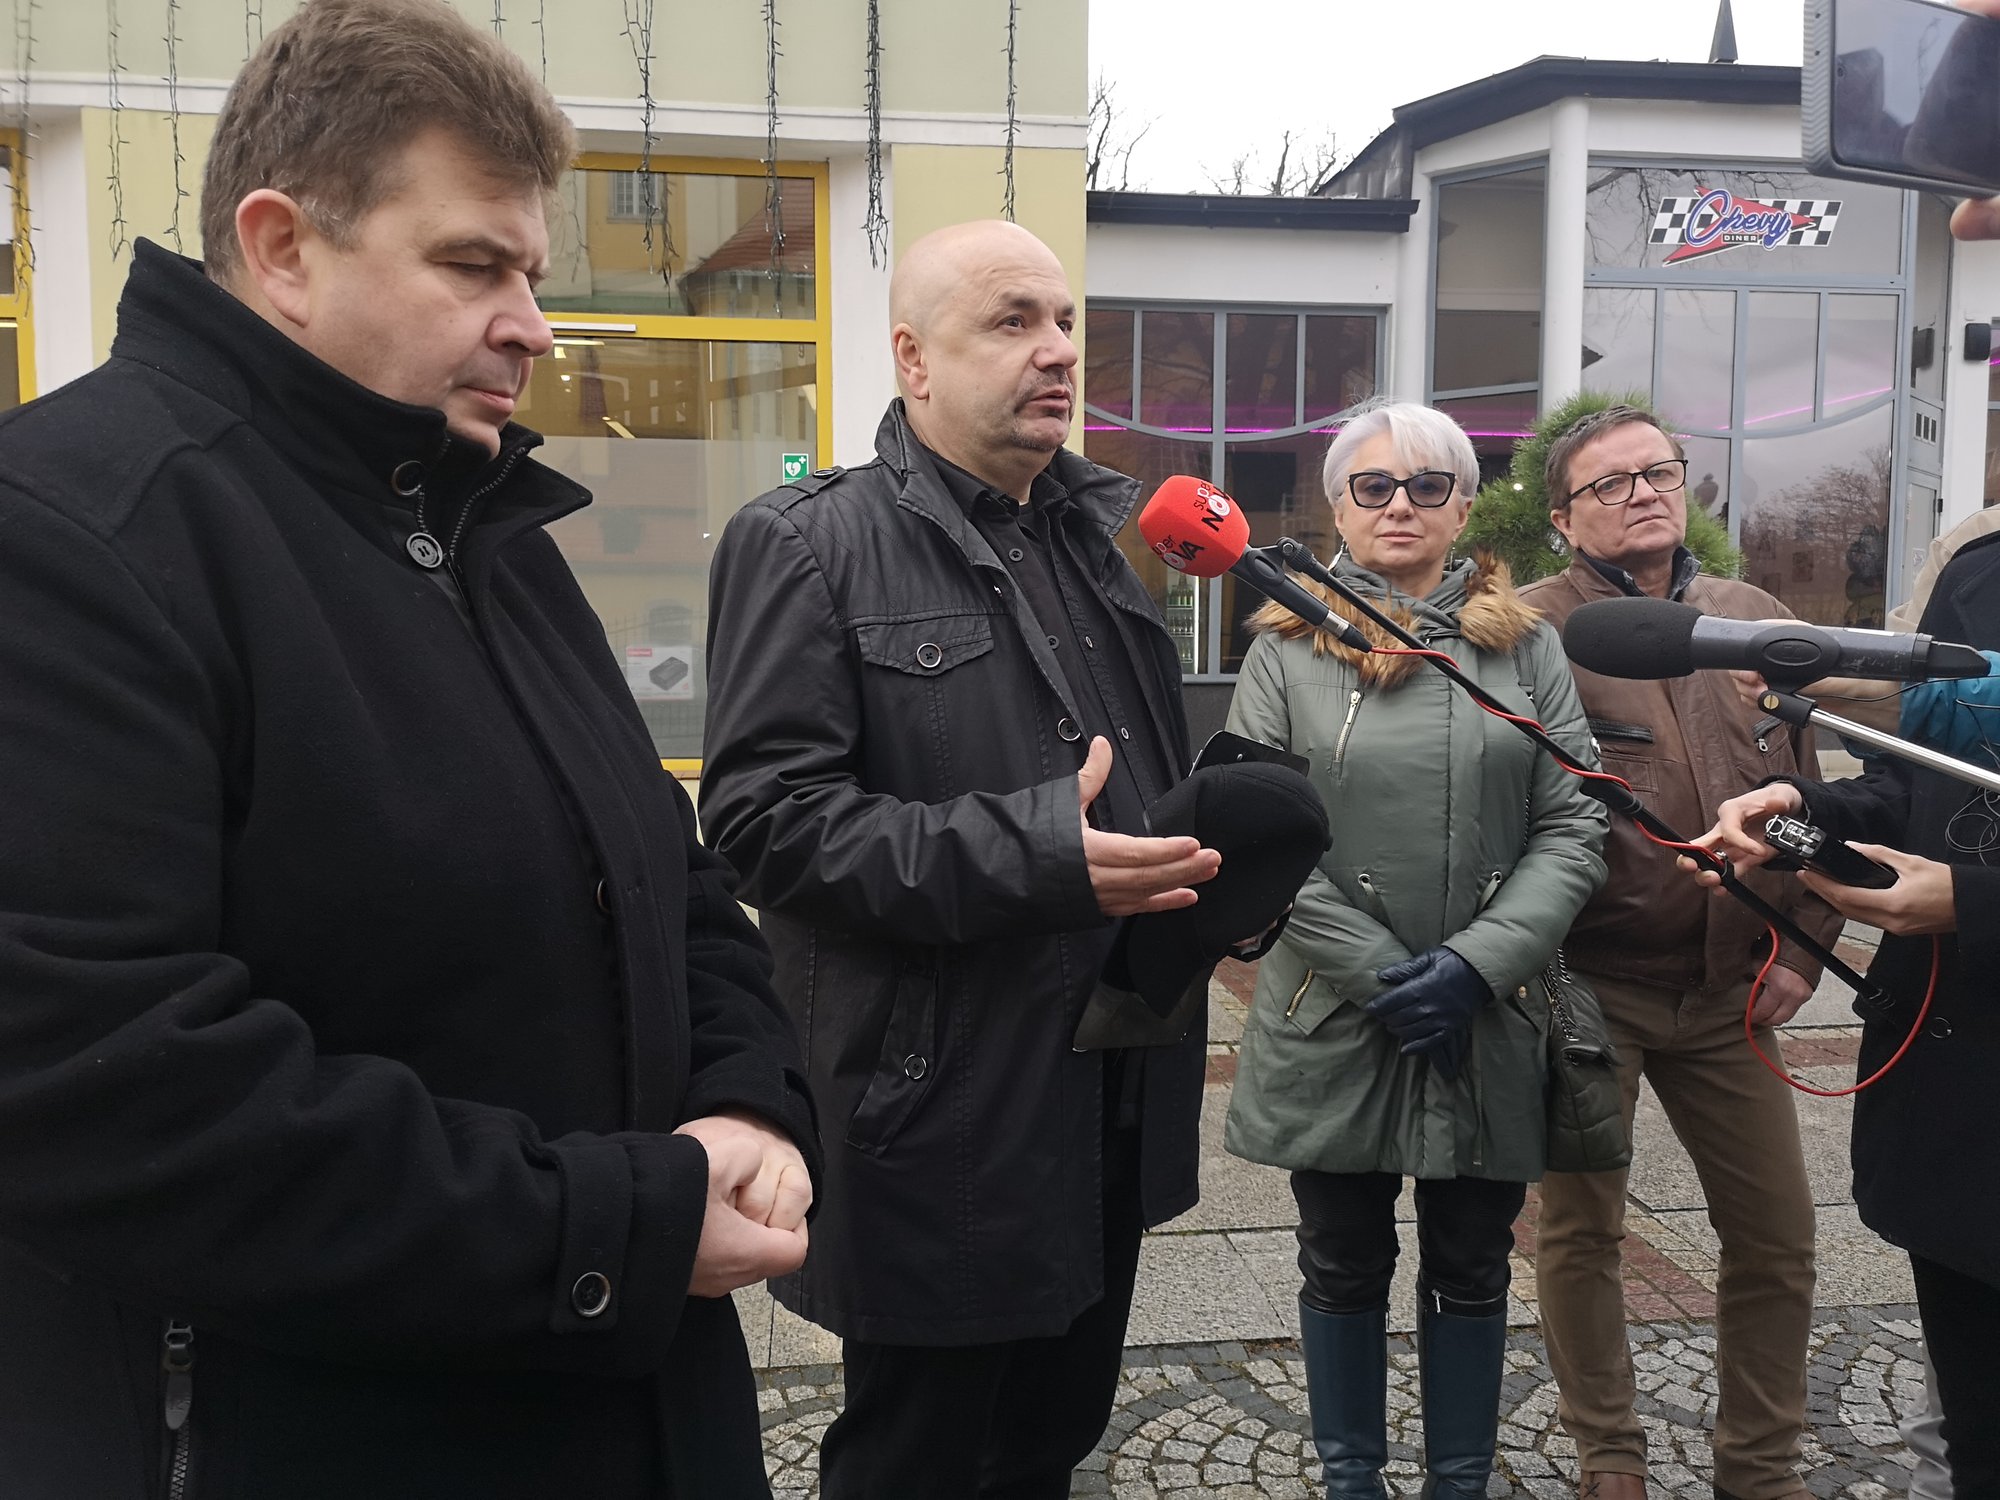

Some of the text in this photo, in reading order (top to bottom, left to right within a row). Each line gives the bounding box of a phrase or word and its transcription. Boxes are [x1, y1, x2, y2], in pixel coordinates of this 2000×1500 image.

[1685, 189, 1792, 250] Chevy
[1723, 234, 1758, 242] DINER
[1201, 485, 1231, 532] NOV
[1152, 534, 1175, 556] uper
